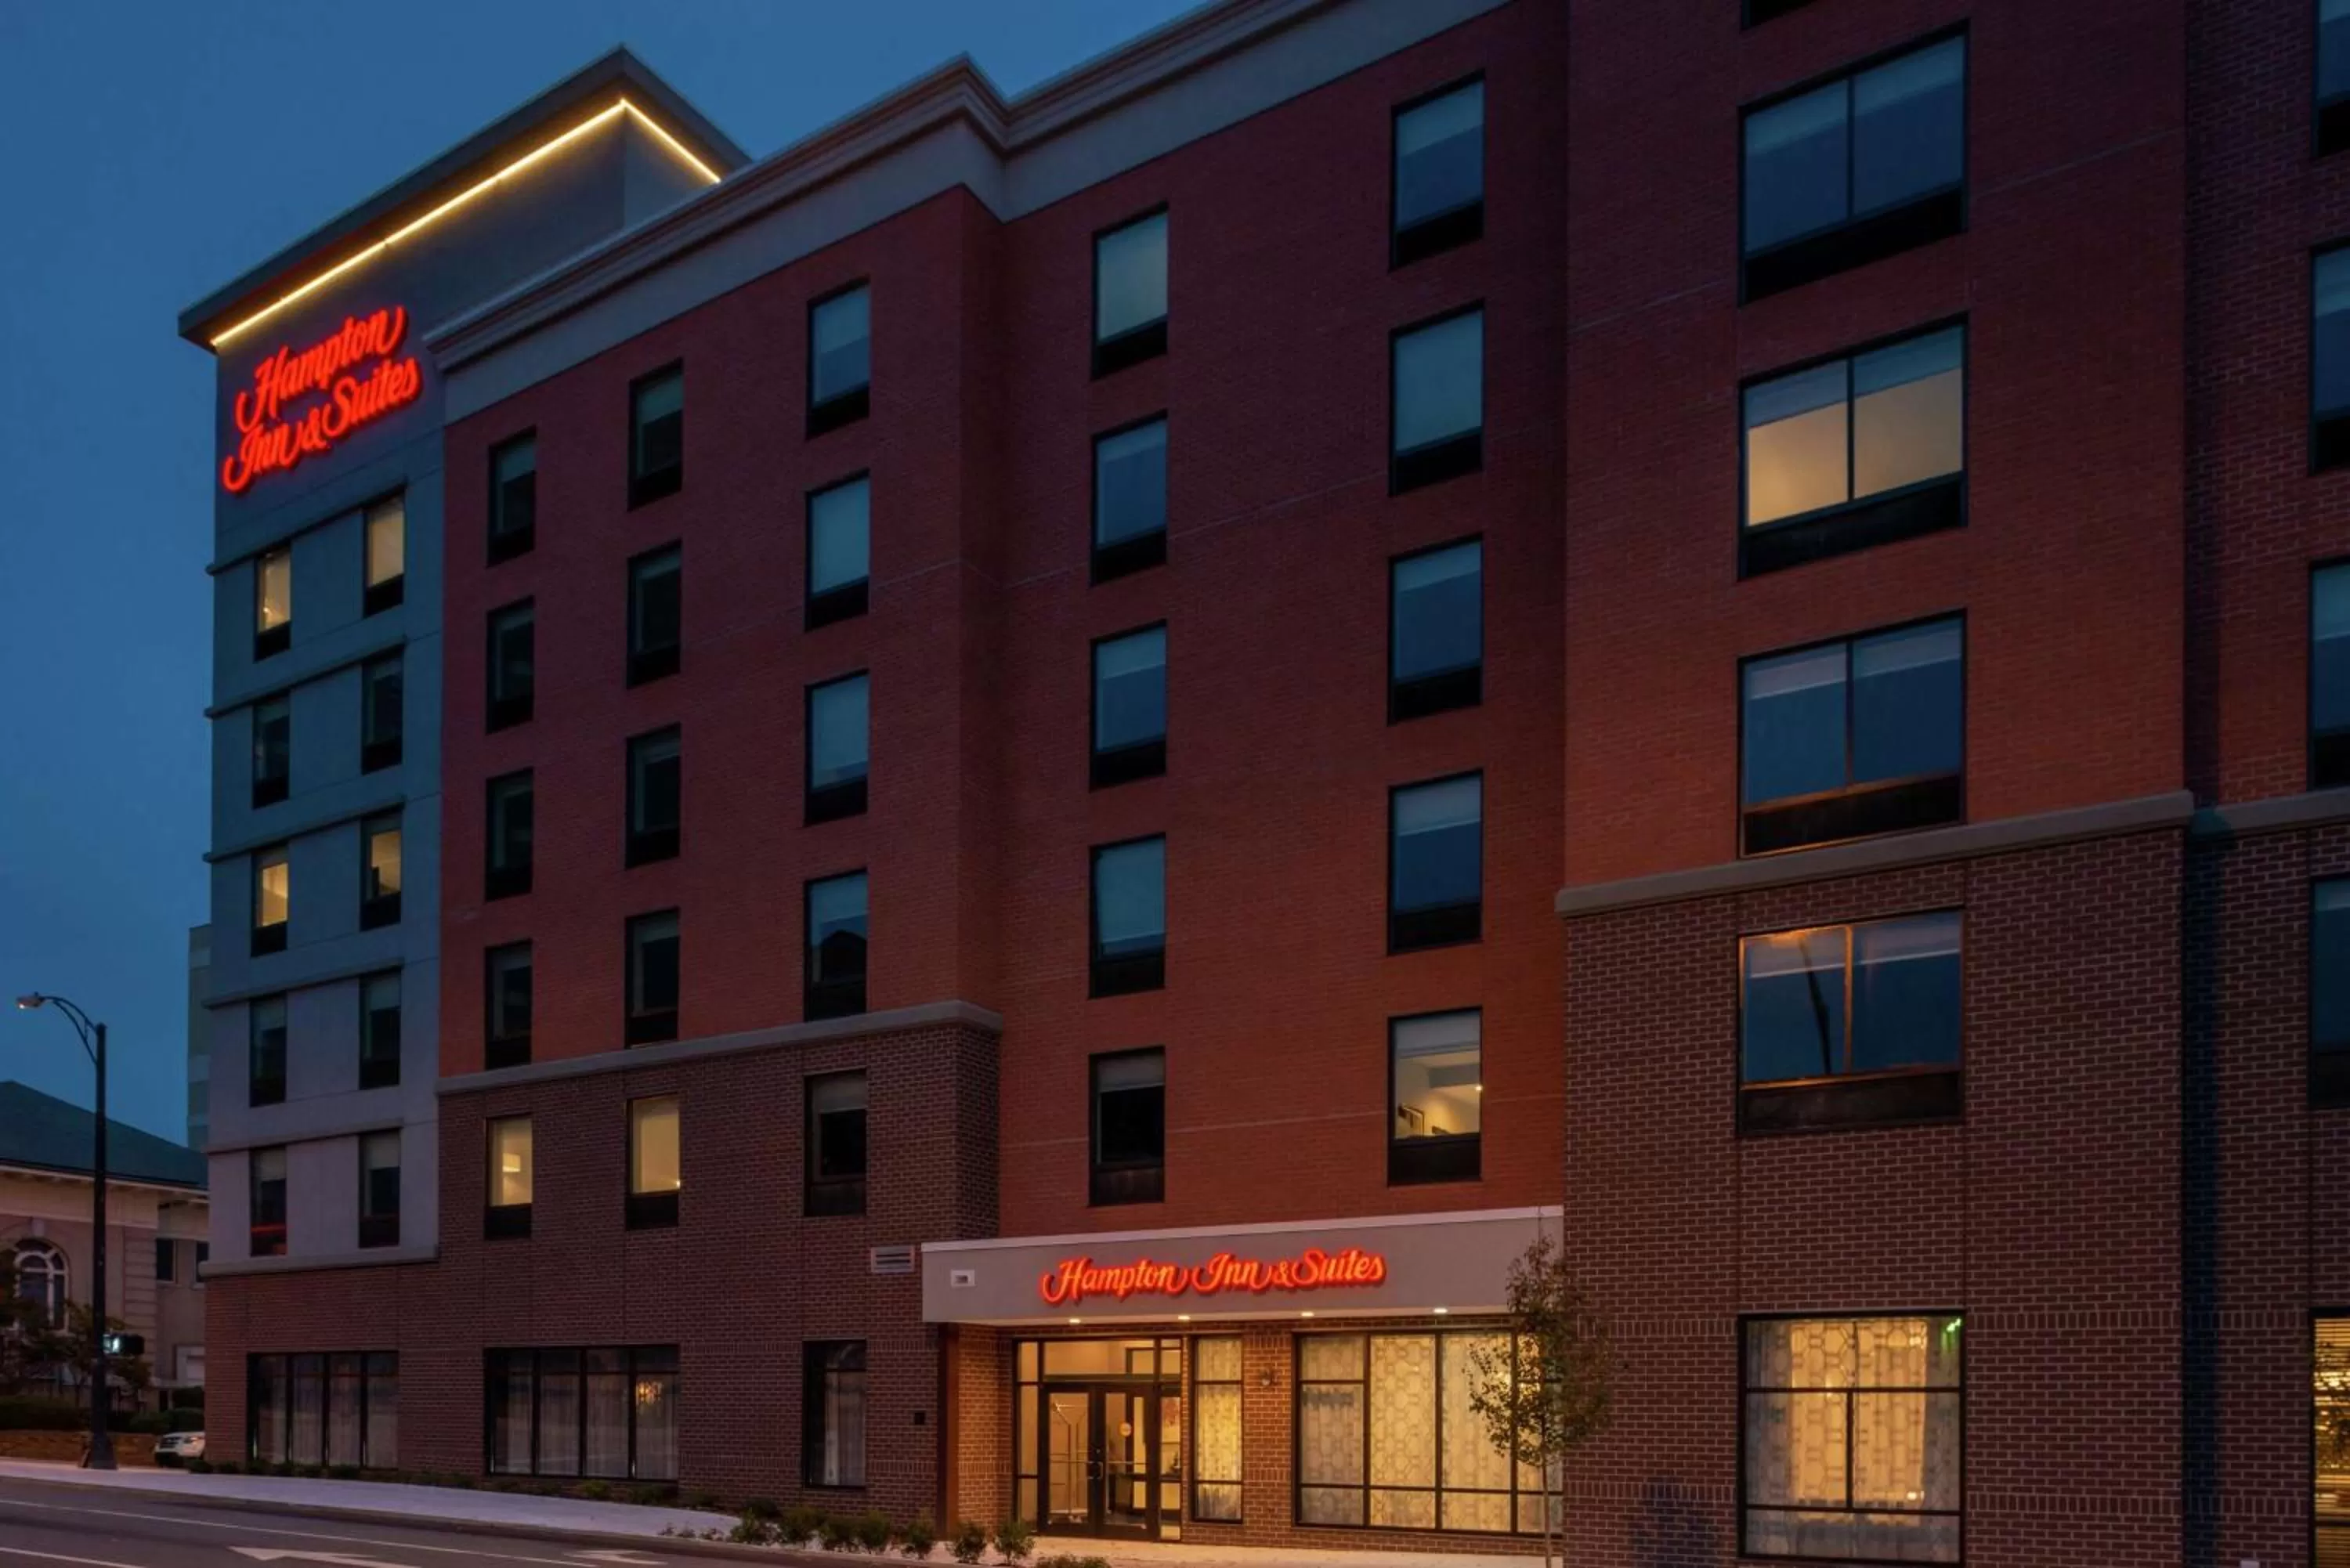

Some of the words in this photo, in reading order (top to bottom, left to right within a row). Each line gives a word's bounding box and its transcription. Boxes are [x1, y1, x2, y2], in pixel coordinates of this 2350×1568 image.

[222, 422, 302, 491] Inn
[302, 408, 327, 450] &
[322, 358, 418, 437] Suites
[236, 306, 404, 432] Hampton
[1041, 1257, 1189, 1302] Hampton
[1191, 1252, 1273, 1292] Inn
[1272, 1260, 1294, 1288] &
[1292, 1249, 1385, 1284] Suites
